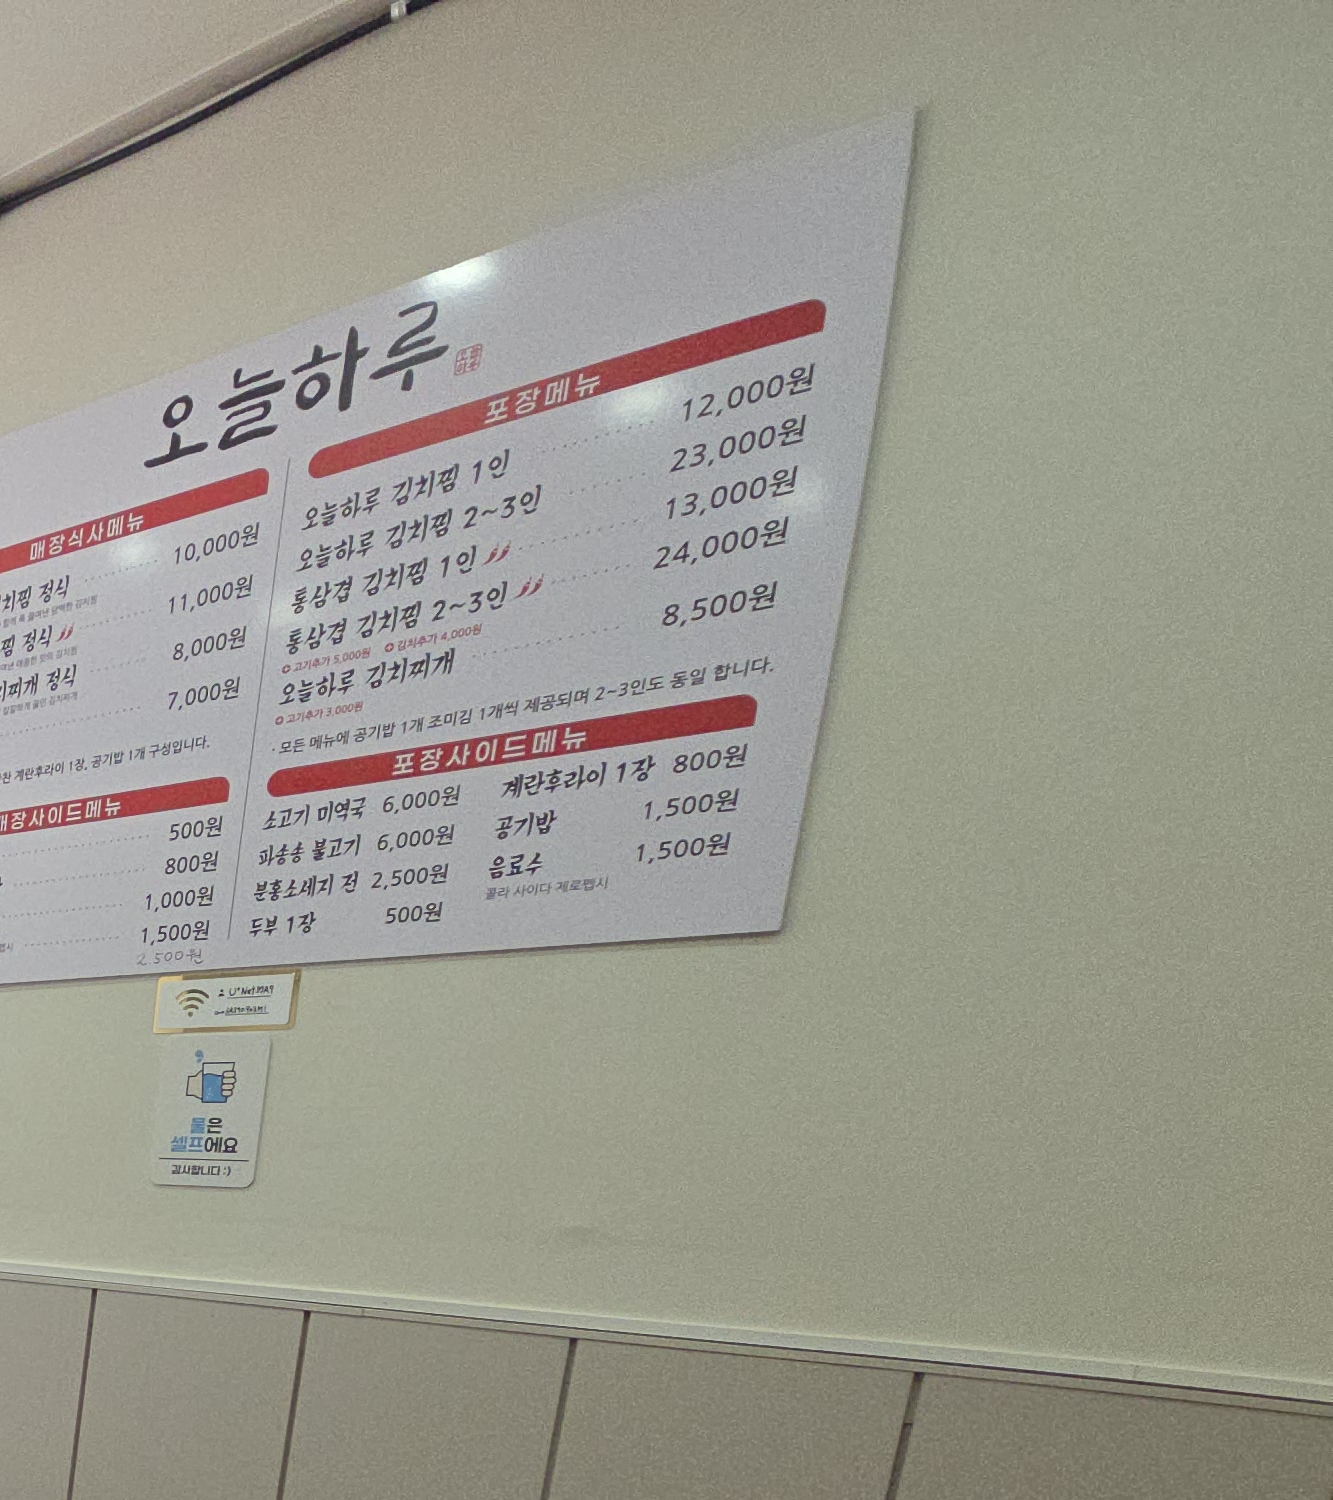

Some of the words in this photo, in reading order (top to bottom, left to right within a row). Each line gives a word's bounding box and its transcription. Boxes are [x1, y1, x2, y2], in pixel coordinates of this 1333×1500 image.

[144, 301, 449, 468] 오늘하루
[484, 373, 601, 424] 포장메뉴
[301, 487, 380, 530] 오늘하루
[391, 463, 460, 506] 김치찜
[472, 449, 510, 485] 1인
[682, 364, 815, 422] 12,000원
[296, 530, 375, 572] 오늘하루
[386, 508, 453, 550] 김치찜
[463, 484, 542, 529] 2~3인
[669, 415, 807, 473] 23,000원
[29, 512, 144, 561] 매장식사메뉴
[291, 576, 353, 615] 통삼겹
[363, 557, 428, 597] 김치찜
[440, 545, 477, 578] 1인
[666, 466, 798, 520] 13,000원
[38, 575, 71, 606] 정식
[174, 522, 261, 565] 10,000원
[286, 618, 347, 655] 통삼겹
[357, 601, 422, 638] 김치찜
[432, 581, 508, 622] 2~3인
[653, 516, 790, 570] 24,000원
[23, 625, 52, 652] 정식
[167, 574, 254, 614] 11,000원
[46, 664, 76, 691] 정식
[172, 625, 247, 662] 8,000원
[279, 668, 355, 705] 오늘하루
[365, 647, 455, 688] 김치찌개
[661, 581, 778, 628] 8,500원
[168, 677, 241, 711] 7,000원
[279, 737, 305, 753] 모든
[309, 730, 349, 748] 메뉴에
[353, 721, 395, 742] 공기밥
[401, 717, 423, 733] 1개
[427, 710, 472, 729] 조미김
[480, 700, 519, 720] 1개씩
[523, 688, 590, 714] 제공되며
[594, 676, 664, 701] 2~3인도
[669, 667, 706, 688] 동일
[714, 656, 774, 681] 합니다.
[14, 762, 64, 781] 계란후라이
[91, 751, 125, 769] 공기밥
[129, 748, 145, 762] 1개
[150, 736, 210, 759] 구성입니다.
[392, 727, 587, 776] 포장사이드메뉴
[501, 762, 607, 798] 계란후라이
[616, 755, 656, 783] 1장
[673, 743, 748, 773] 800원
[169, 816, 223, 842] 500원
[263, 804, 310, 831] 소고기
[317, 797, 366, 823] 미역국
[383, 785, 460, 814] 6,000원
[495, 809, 557, 840] 공기밥
[644, 788, 740, 821] 1,500원
[164, 851, 218, 875] 800원
[259, 841, 304, 866] 파송송
[312, 834, 361, 861] 불고기
[377, 824, 455, 852] 6,000원
[489, 852, 543, 879] 음료수
[636, 832, 731, 863] 1,500원
[145, 885, 214, 913] 1,000원
[253, 873, 333, 901] 분홍소세지
[341, 871, 359, 893] 전
[371, 863, 448, 890] 2,500원
[141, 920, 210, 946] 1,500원
[249, 916, 278, 937] 두부
[286, 911, 316, 934] 1장
[385, 902, 442, 925] 500원
[191, 1117, 223, 1134] 물은
